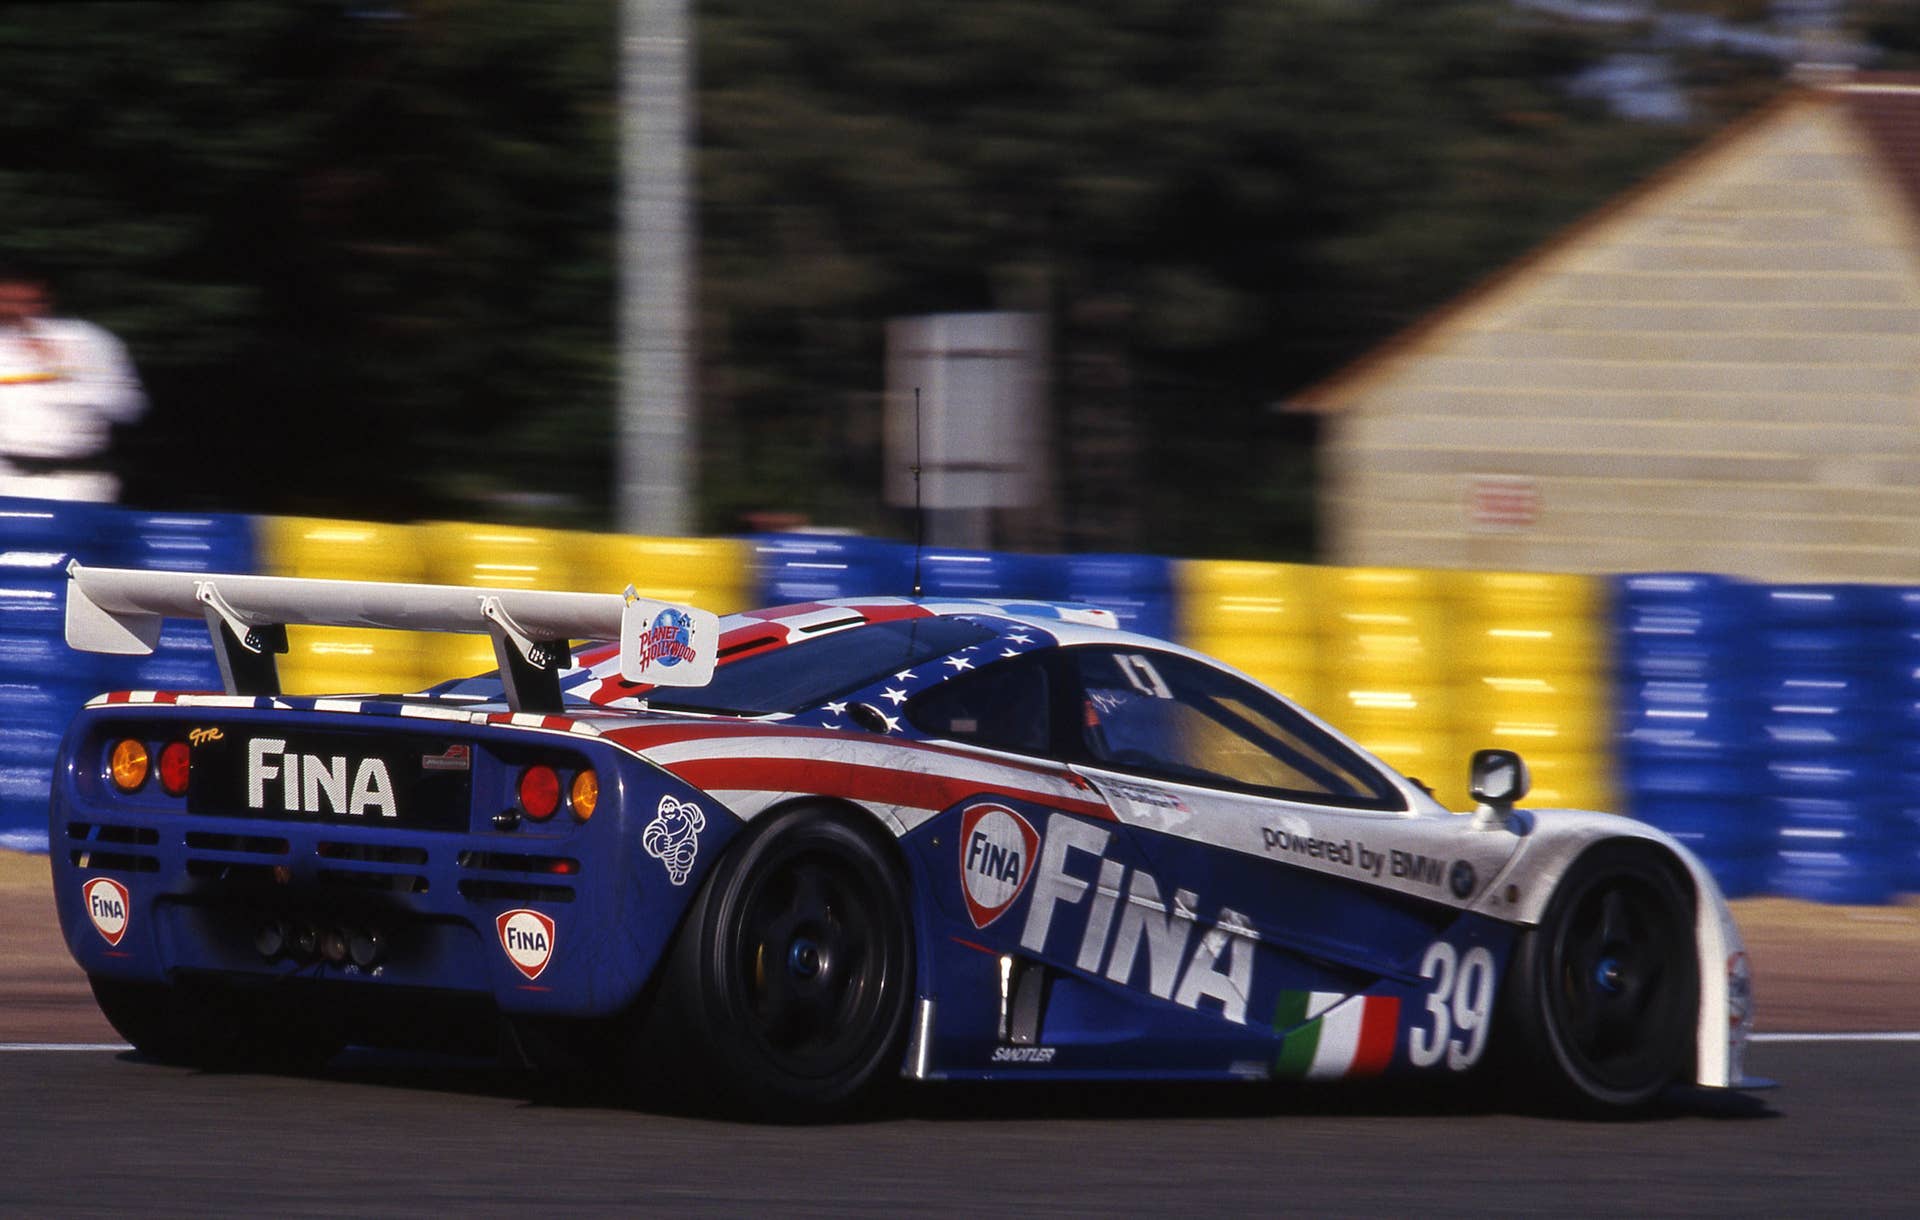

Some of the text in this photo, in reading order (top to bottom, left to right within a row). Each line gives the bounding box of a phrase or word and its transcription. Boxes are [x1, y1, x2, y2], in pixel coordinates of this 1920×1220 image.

[639, 626, 679, 656] PLANET
[639, 641, 696, 673] HOLLYWOOD
[189, 728, 224, 747] GTR
[248, 738, 397, 817] FINA
[966, 831, 1021, 886] FINA
[1262, 826, 1353, 866] powered
[1358, 842, 1385, 878] by
[1389, 849, 1447, 886] BMW
[91, 895, 124, 919] FINA
[1020, 812, 1259, 1025] FINA
[507, 926, 547, 952] FINA
[1408, 941, 1496, 1071] 39
